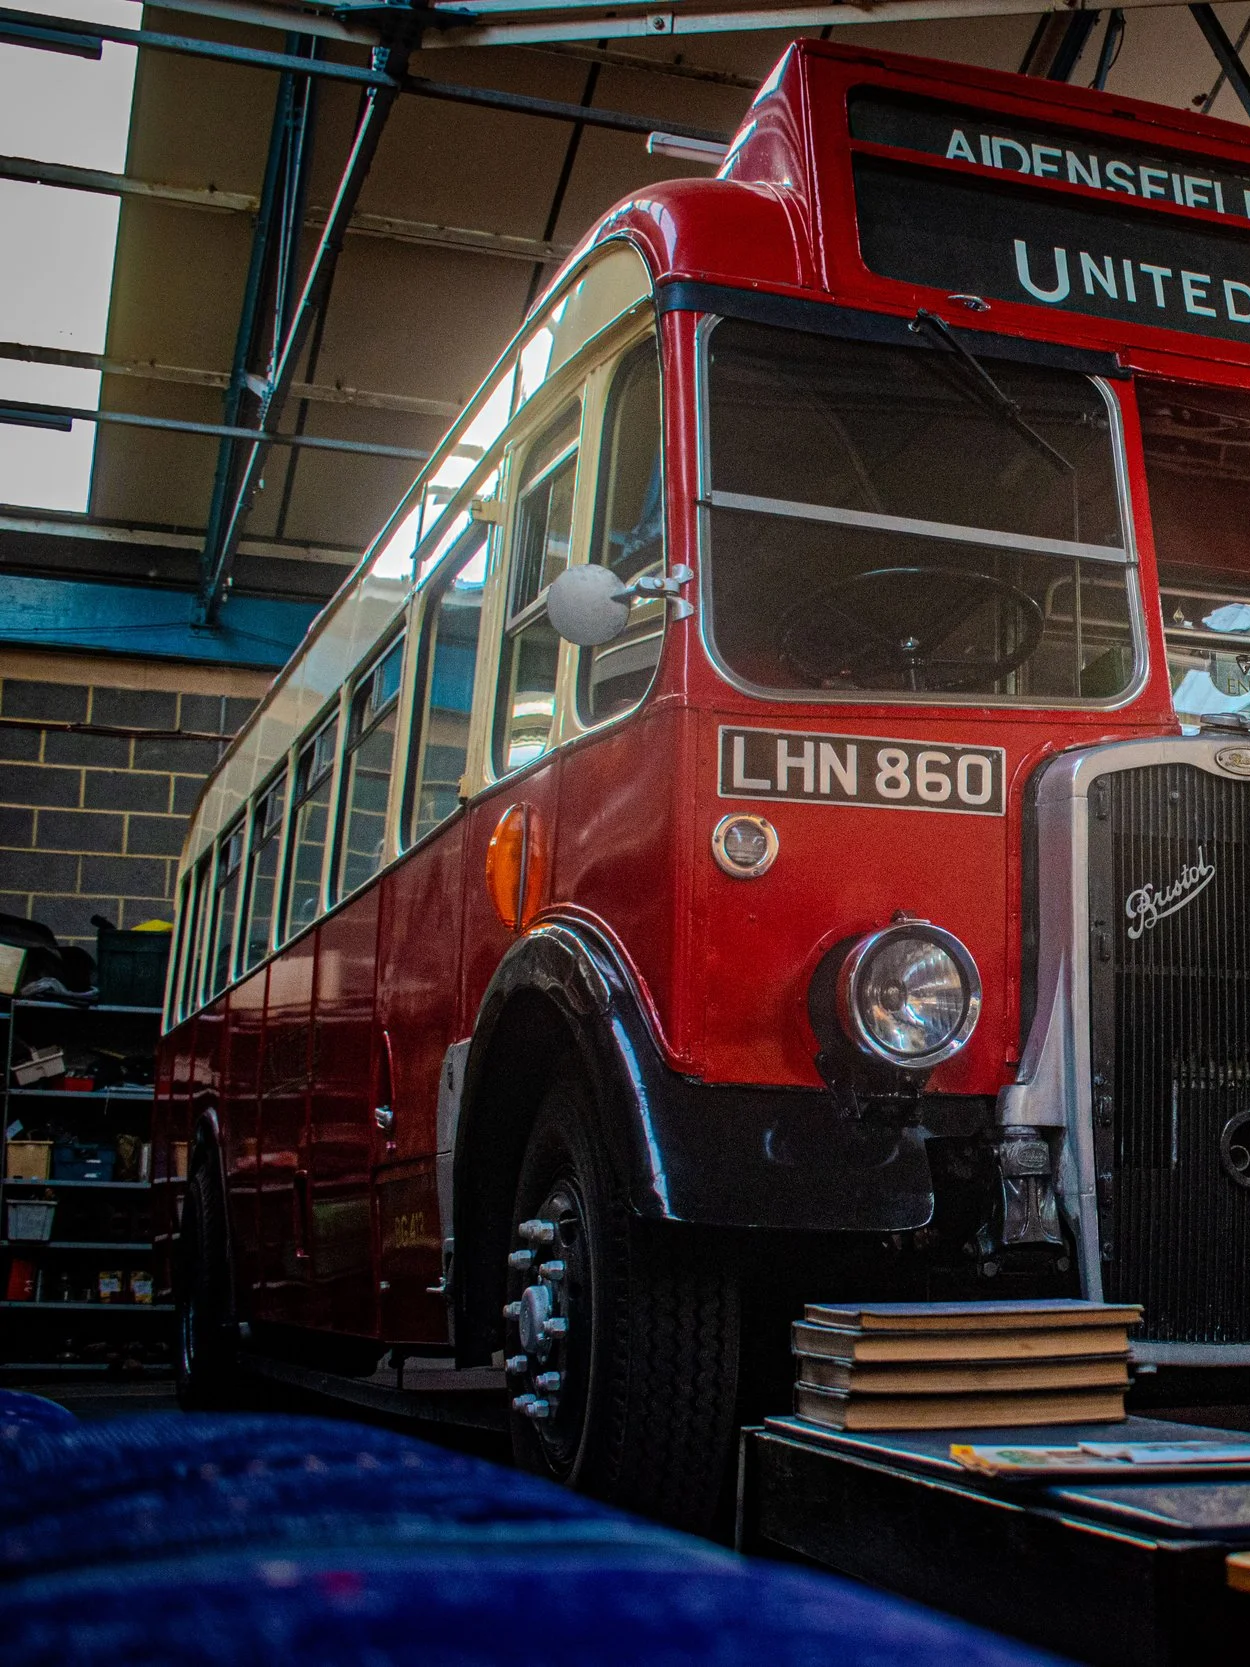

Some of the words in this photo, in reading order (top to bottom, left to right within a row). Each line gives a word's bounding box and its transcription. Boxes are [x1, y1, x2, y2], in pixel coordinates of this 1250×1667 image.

[733, 736, 857, 796] LHN
[875, 748, 992, 805] 860
[1125, 845, 1216, 940] Bristol
